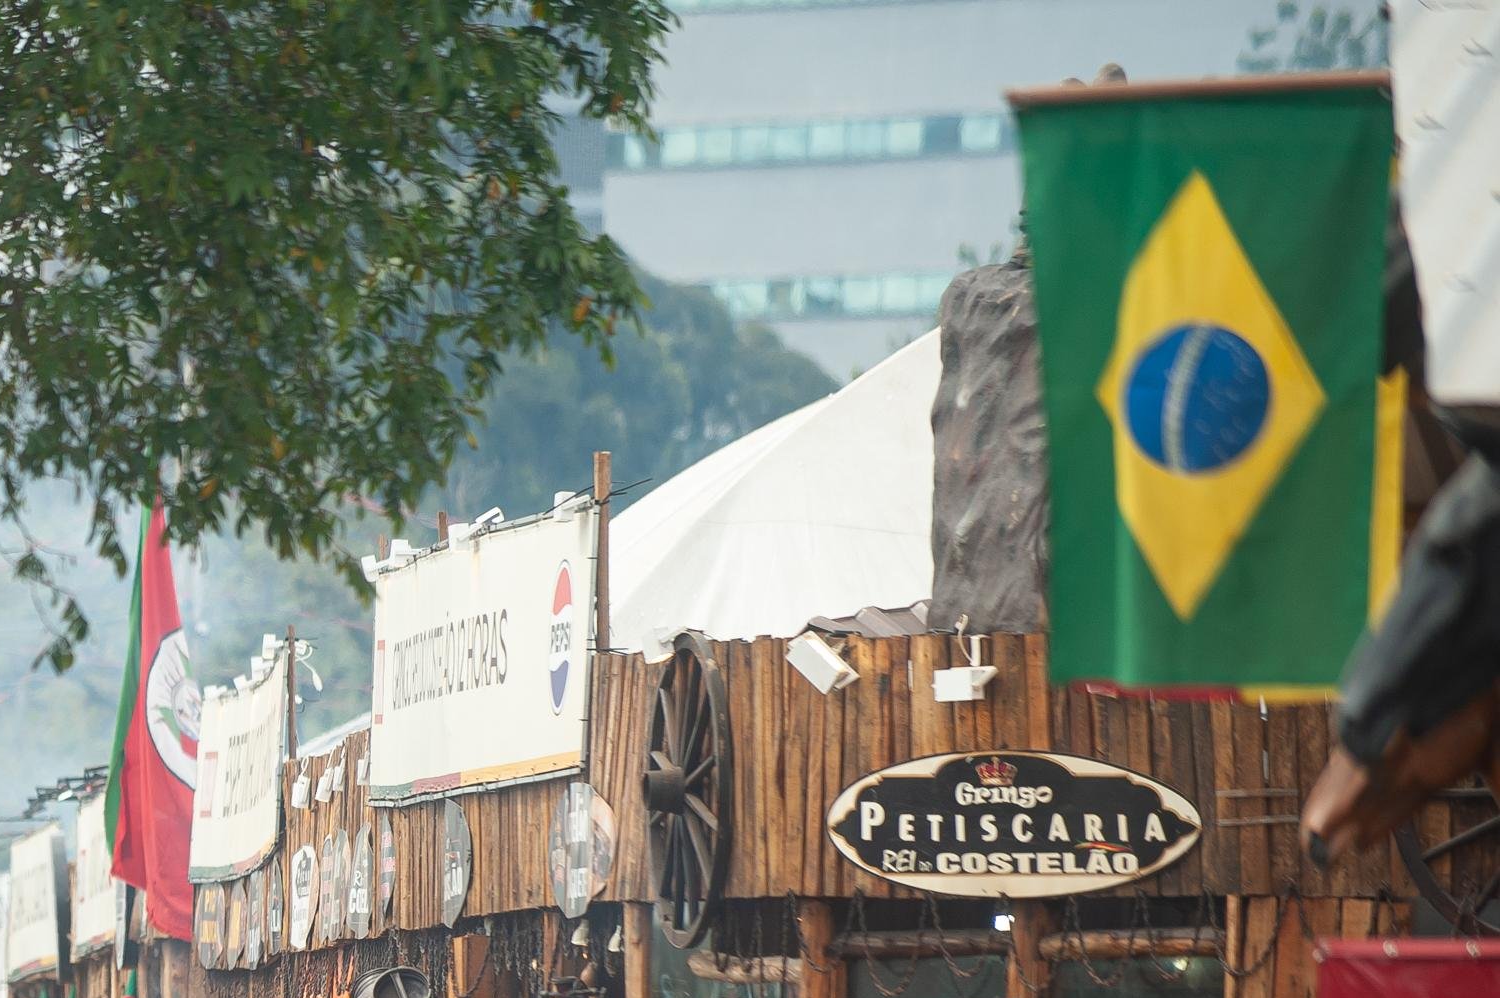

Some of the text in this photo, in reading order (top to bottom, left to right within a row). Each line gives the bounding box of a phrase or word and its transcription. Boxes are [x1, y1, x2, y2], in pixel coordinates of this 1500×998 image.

[466, 608, 508, 690] HORAS
[955, 781, 1054, 808] Gringo
[859, 801, 1167, 842] PETISCARIA
[935, 850, 1140, 876] COSTELÃO
